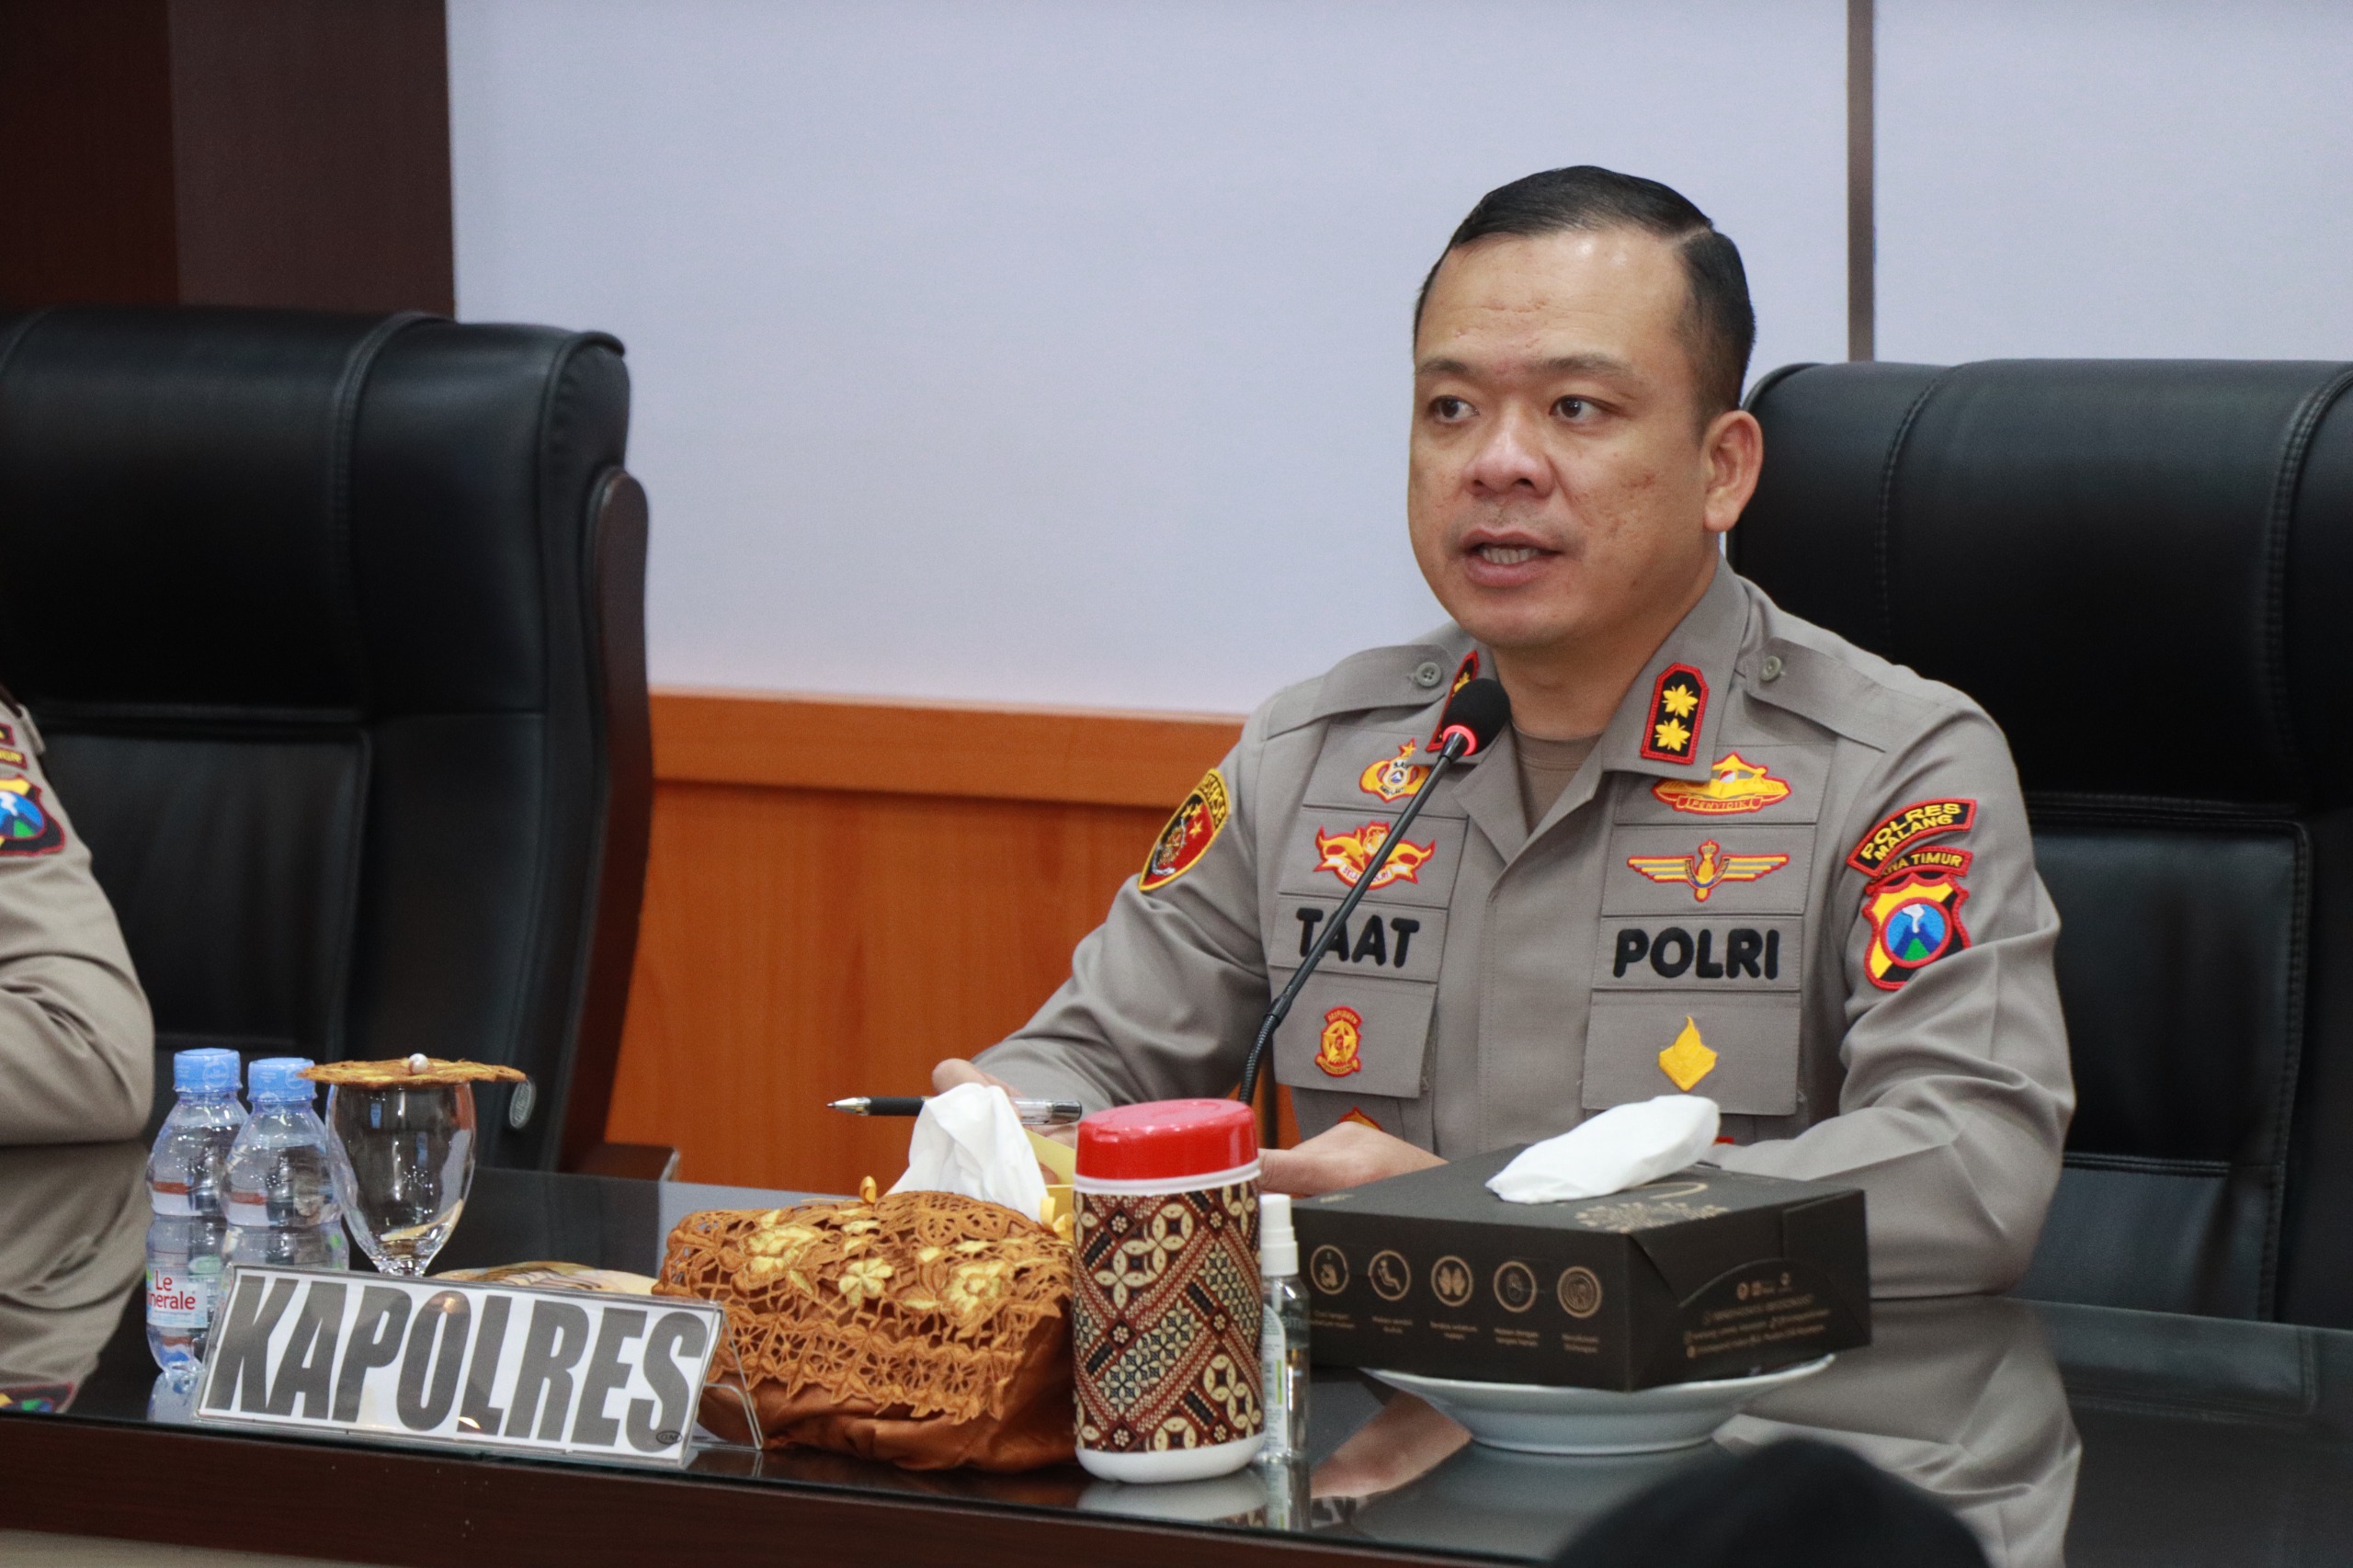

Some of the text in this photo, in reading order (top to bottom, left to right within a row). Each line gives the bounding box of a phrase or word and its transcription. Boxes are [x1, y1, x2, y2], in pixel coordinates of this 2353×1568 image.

[1860, 802, 1961, 859] POLRES
[1873, 814, 1953, 860] MALANG
[1911, 852, 1963, 868] TIMUR
[1296, 907, 1420, 968] TAAT
[1613, 926, 1779, 980] POLRI
[147, 1290, 196, 1310] nerale
[155, 1269, 173, 1291] Le
[204, 1275, 708, 1452] KAPOLRES
